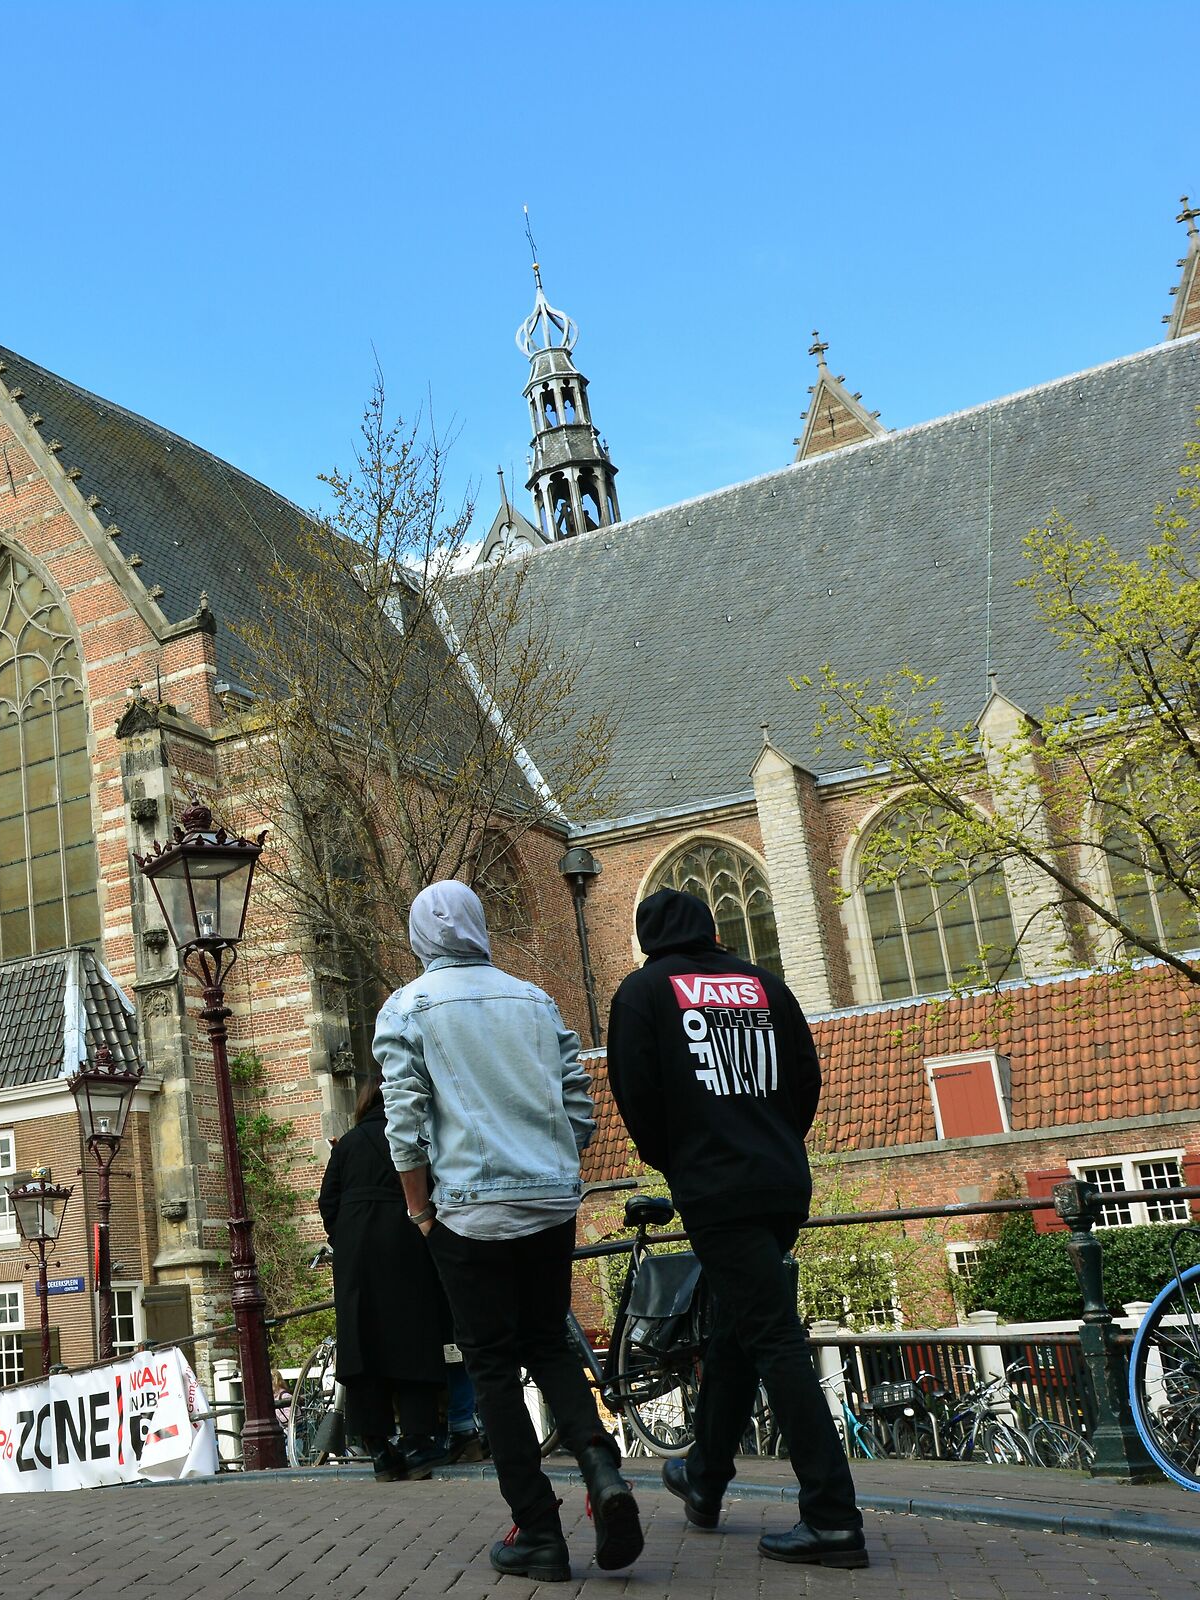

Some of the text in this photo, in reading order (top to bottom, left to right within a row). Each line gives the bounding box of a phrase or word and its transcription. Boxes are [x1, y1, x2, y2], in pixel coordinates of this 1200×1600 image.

[674, 977, 759, 1004] VANS
[705, 1007, 773, 1029] THE
[683, 1009, 722, 1096] OFF
[47, 1279, 79, 1288] DEKERKSPLEIN
